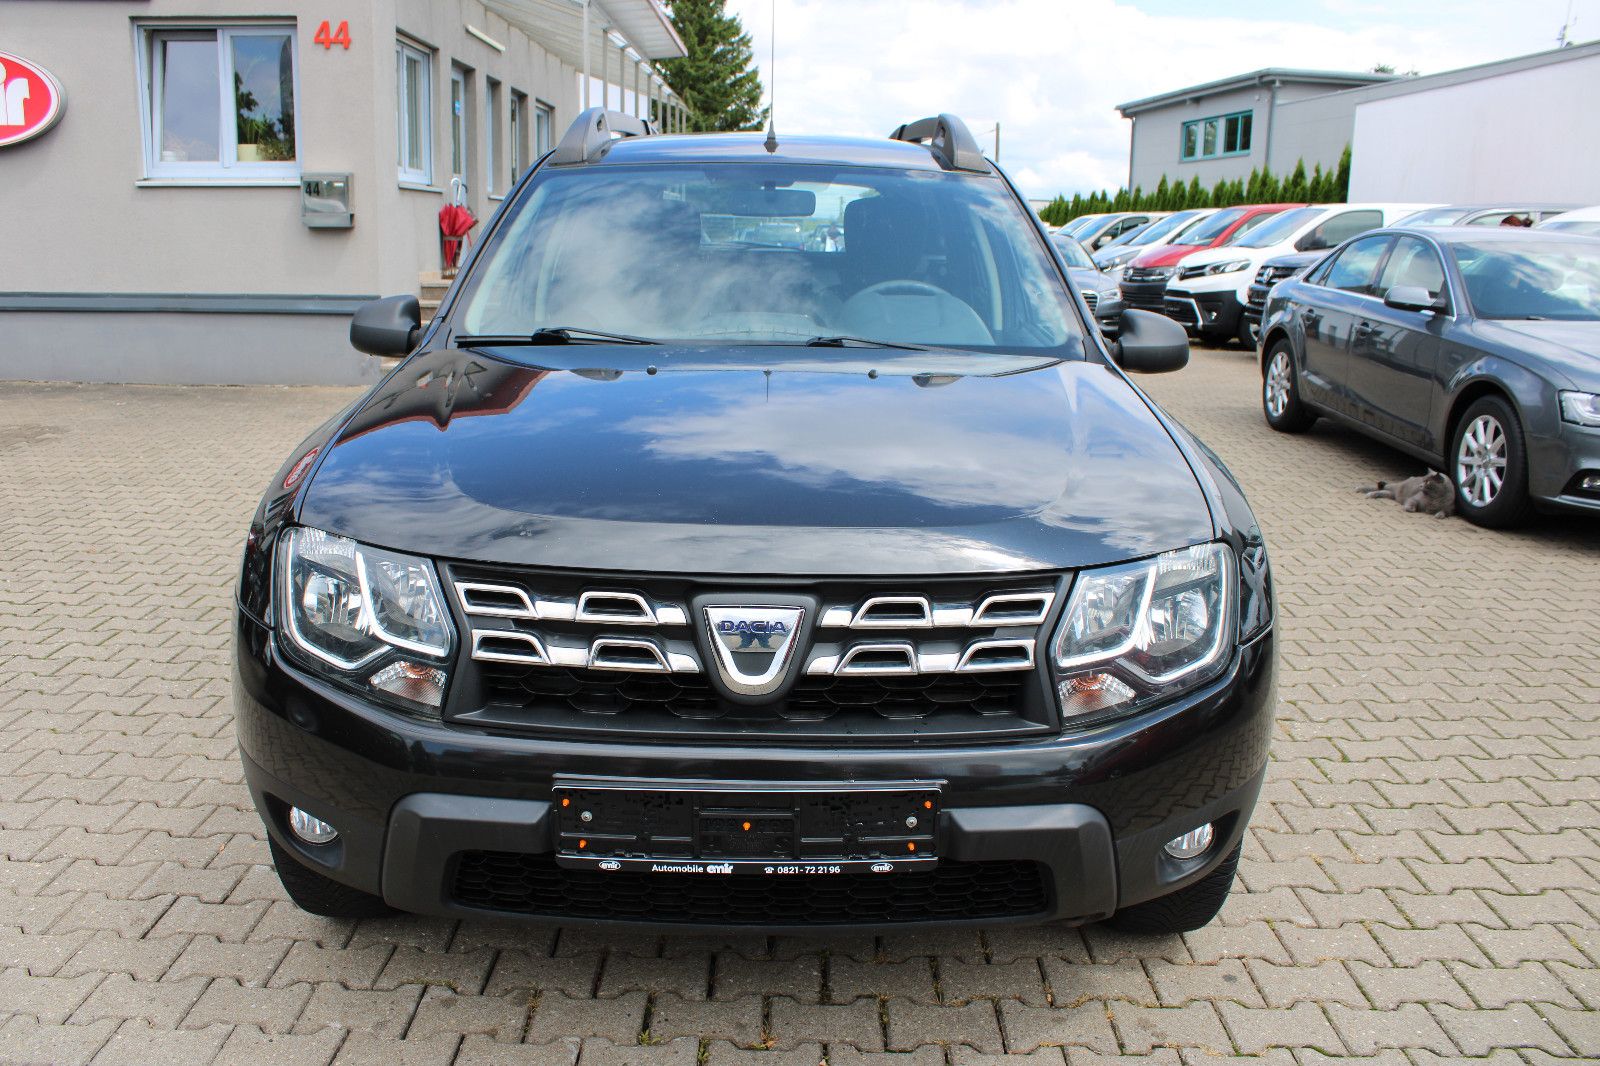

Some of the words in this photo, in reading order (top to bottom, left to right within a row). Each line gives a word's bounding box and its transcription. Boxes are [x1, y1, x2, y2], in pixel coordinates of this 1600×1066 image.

[313, 20, 352, 50] 44
[305, 182, 320, 197] 44
[720, 620, 787, 634] DACIA
[651, 864, 704, 873] Automobile
[706, 863, 734, 874] emir
